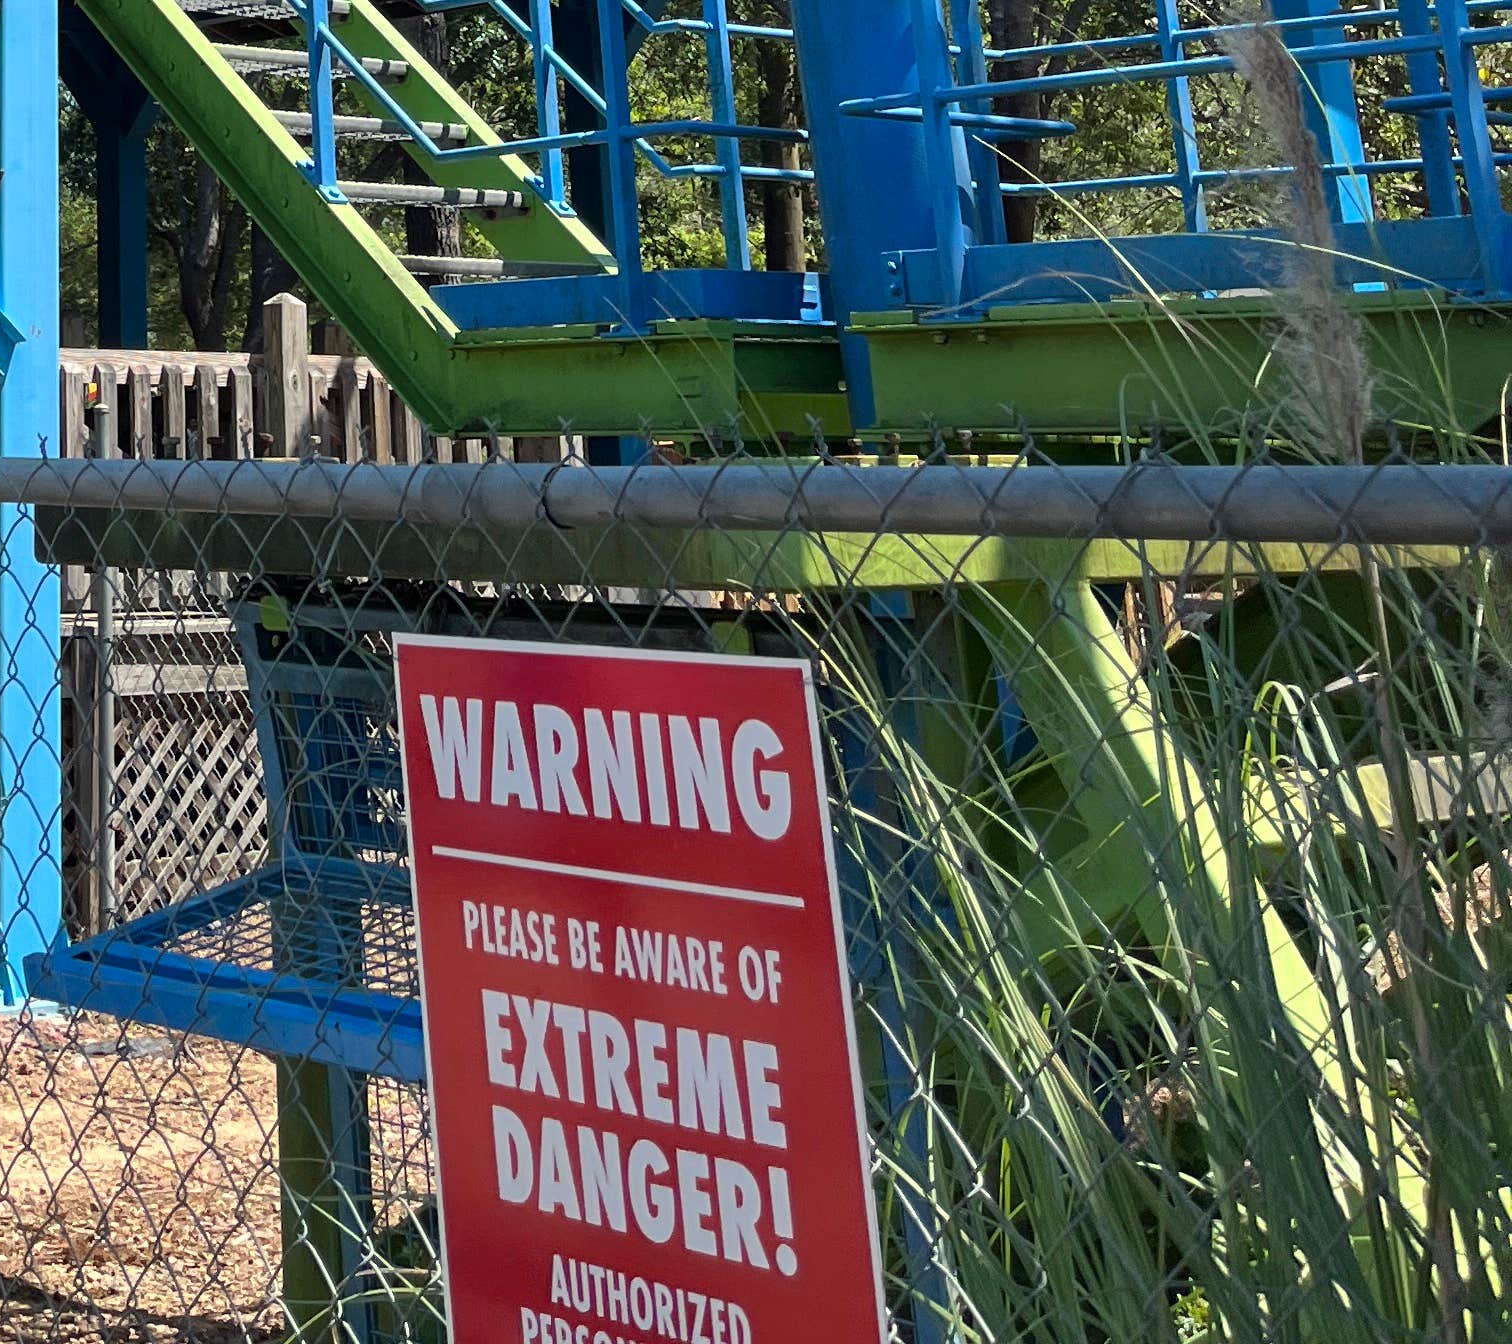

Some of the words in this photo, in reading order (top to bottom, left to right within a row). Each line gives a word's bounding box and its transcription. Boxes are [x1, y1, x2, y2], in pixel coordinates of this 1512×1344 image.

[419, 693, 792, 842] WARNING
[462, 900, 561, 967] PLEASE
[567, 917, 605, 975] BE
[614, 925, 729, 996] AWARE
[738, 944, 783, 1005] OF
[481, 988, 788, 1150] EXTREME
[491, 1104, 799, 1278] DANGER!
[551, 1253, 753, 1344] AUTHORIZED
